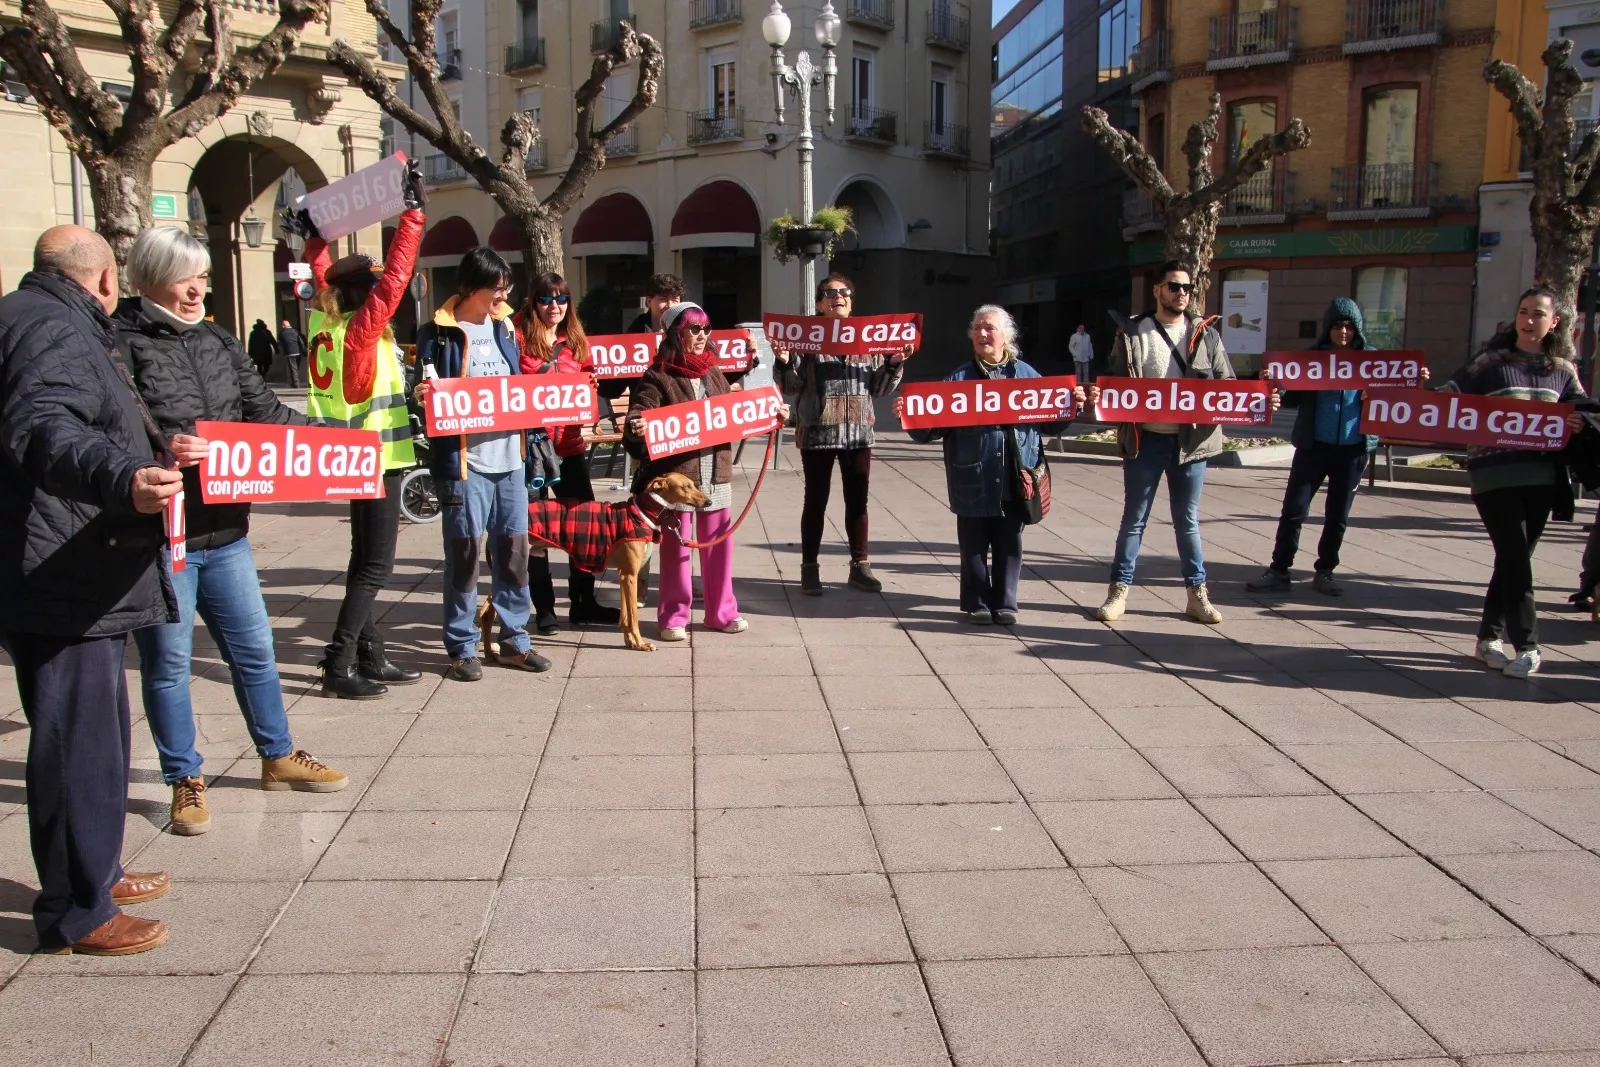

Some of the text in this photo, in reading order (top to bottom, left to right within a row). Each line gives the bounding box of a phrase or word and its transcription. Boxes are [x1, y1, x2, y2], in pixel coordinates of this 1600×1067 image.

[1229, 239, 1276, 248] CAJA RURAL
[768, 318, 916, 343] no a la caza
[590, 344, 626, 366] no
[633, 343, 649, 363] a
[787, 341, 822, 350] perros
[614, 364, 648, 377] perros
[1268, 354, 1418, 380] no a la caza
[432, 378, 591, 417] no a la caza
[906, 384, 1071, 416] no a la caza
[1102, 382, 1266, 412] no a la caza
[435, 416, 495, 432] con perros
[648, 396, 780, 443] no a la caza
[1368, 397, 1564, 438] no a la caza
[207, 429, 376, 477] no a la caza
[651, 435, 700, 455] con perros
[207, 480, 274, 499] con perros
